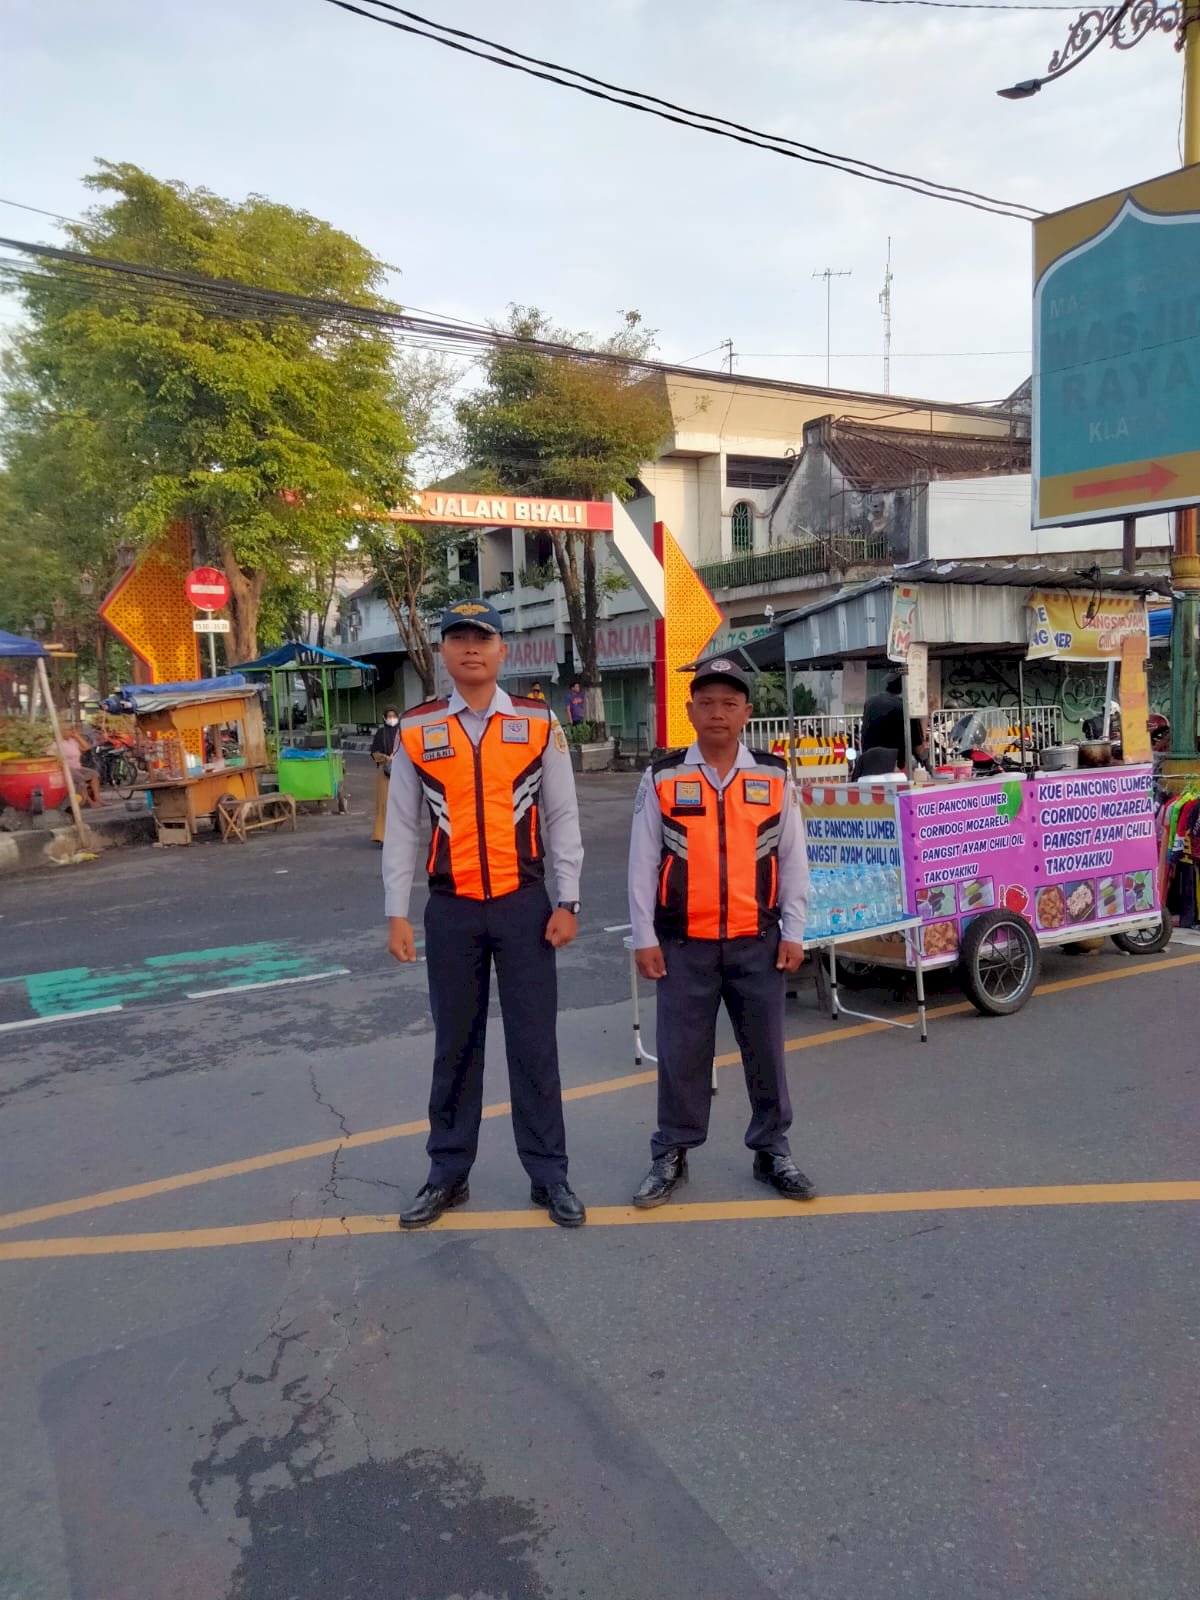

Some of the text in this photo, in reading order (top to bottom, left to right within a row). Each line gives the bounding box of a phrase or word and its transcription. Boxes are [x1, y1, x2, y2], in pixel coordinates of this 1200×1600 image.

[429, 495, 507, 520] JALAN
[514, 501, 583, 523] BHALI
[596, 623, 650, 659] ARUM
[1040, 776, 1153, 800] KUE PANCONG LUMER
[918, 793, 1007, 816] KUE PANCONG LUMER
[1041, 799, 1153, 825] CORNDOG MOZARELA
[807, 820, 895, 840] KUE PANCONG LUMER
[920, 815, 1009, 839] CORNDOG MOZARELA
[1044, 821, 1152, 850] PANGSIT AYAM CHILI
[807, 845, 837, 863] ANGSIT
[840, 846, 862, 864] AYAM
[923, 834, 1024, 861] PANGSIT AYAM CHILI OIL
[925, 864, 978, 884] TAKOYAKIKU
[1046, 851, 1113, 874] TAKOYAKIKU
